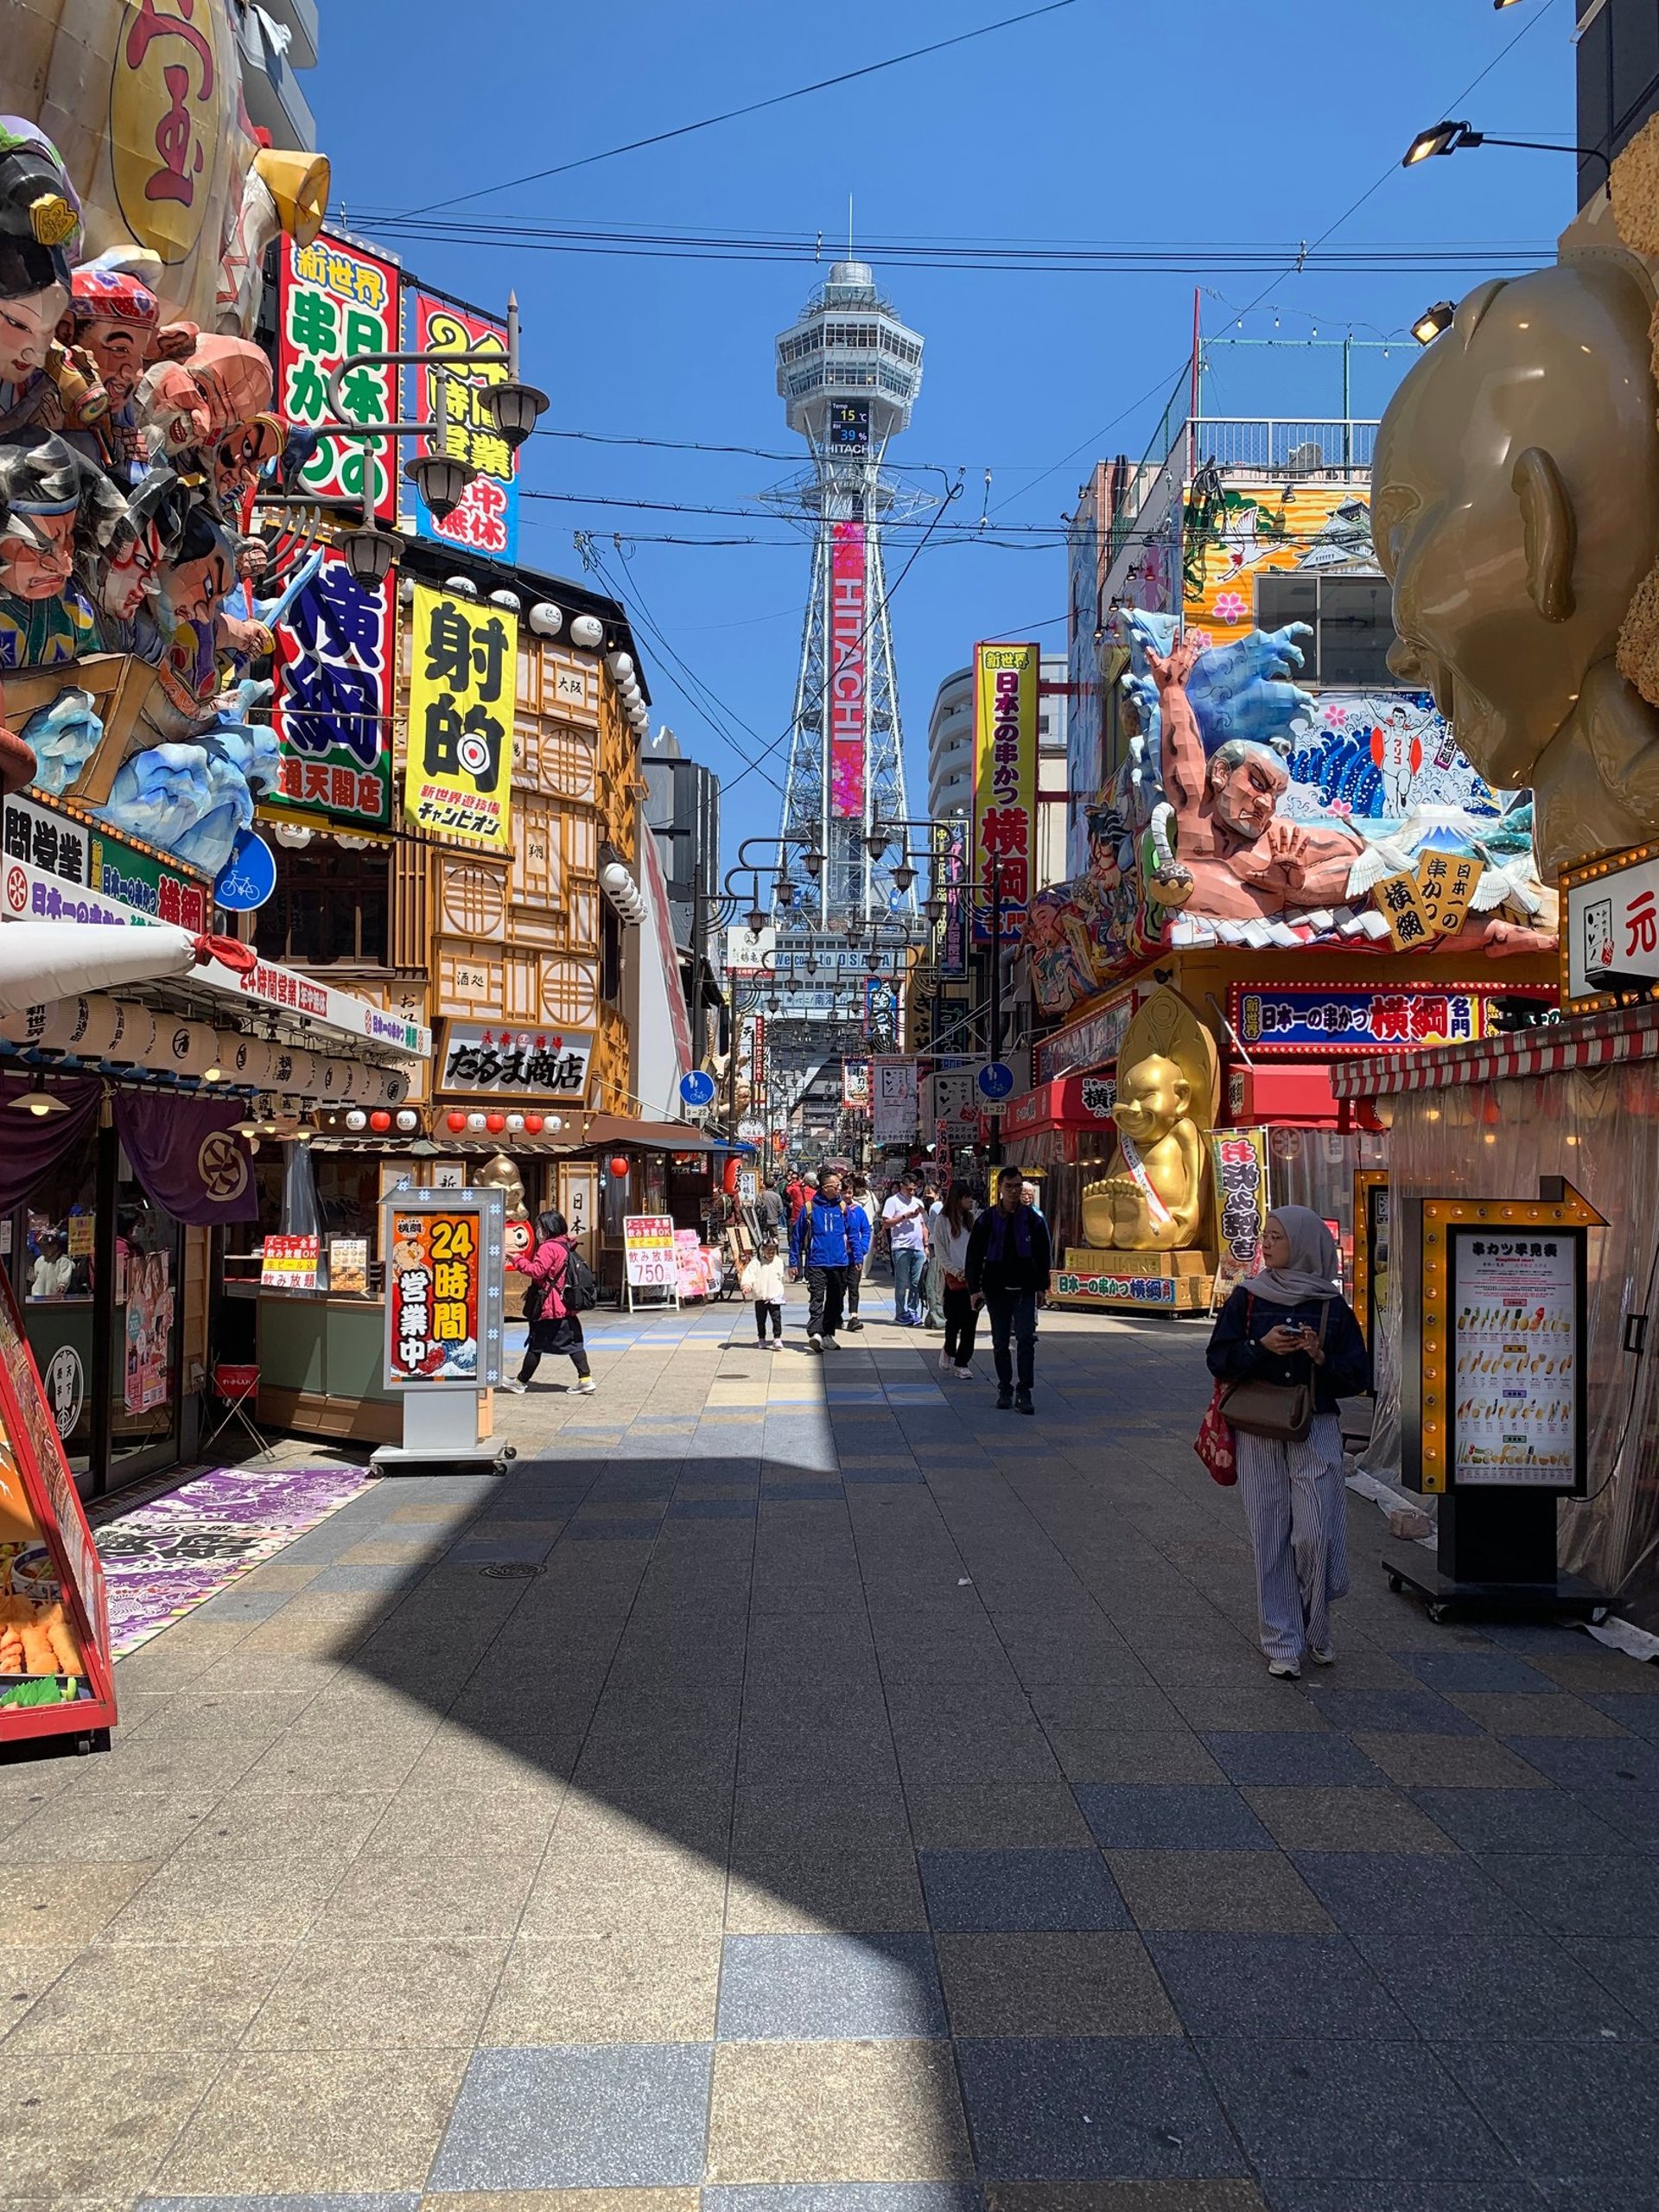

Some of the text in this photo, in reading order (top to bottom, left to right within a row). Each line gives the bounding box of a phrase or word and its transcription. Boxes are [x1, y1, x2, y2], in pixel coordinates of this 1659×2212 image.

[296, 245, 385, 308] 新世界
[841, 410, 855, 421] 15
[841, 430, 855, 441] 39
[834, 578, 862, 741] HITACHI
[985, 652, 1028, 670] 新世界
[423, 601, 508, 792] 射的
[557, 677, 583, 696] 大阪
[993, 671, 1020, 804] 日本一の串かつ
[281, 756, 381, 816] 通天閣店
[420, 785, 499, 816] 新世界遊技場
[418, 802, 500, 836] チャンピオン
[982, 807, 1029, 905] 横綱
[103, 865, 157, 914] 日本一の串かつ
[1442, 862, 1471, 931] 日本一の
[1383, 879, 1426, 943] 横綱
[1625, 890, 1656, 957] 元
[819, 953, 831, 965] to
[457, 970, 485, 988] 酒処
[1244, 998, 1259, 1038] 新世界
[1262, 1003, 1368, 1032] 日本一の串かつ
[1370, 996, 1448, 1040] 横綱
[1452, 999, 1470, 1038] 名門
[448, 1045, 587, 1090] だるま商店
[982, 1105, 1006, 1114] 9-22
[1221, 1141, 1260, 1257] お好み焼き
[626, 1218, 670, 1227] メニュー全部
[627, 1227, 671, 1237] 飲み放題OK
[266, 1249, 316, 1259] 飲み放題OK
[267, 1239, 318, 1249] メニュー全部
[628, 1249, 673, 1262] 飲み放題
[629, 1239, 671, 1248] 生ビール込
[1472, 1241, 1557, 1257] 串カツ早見表
[266, 1260, 315, 1270] 生ビール込
[263, 1274, 316, 1288] 飲み放題
[432, 1222, 473, 1341] 24時間
[1059, 1276, 1128, 1296] 日本一の串かつ
[1129, 1278, 1162, 1300] 横綱
[400, 1272, 429, 1369] 営業中
